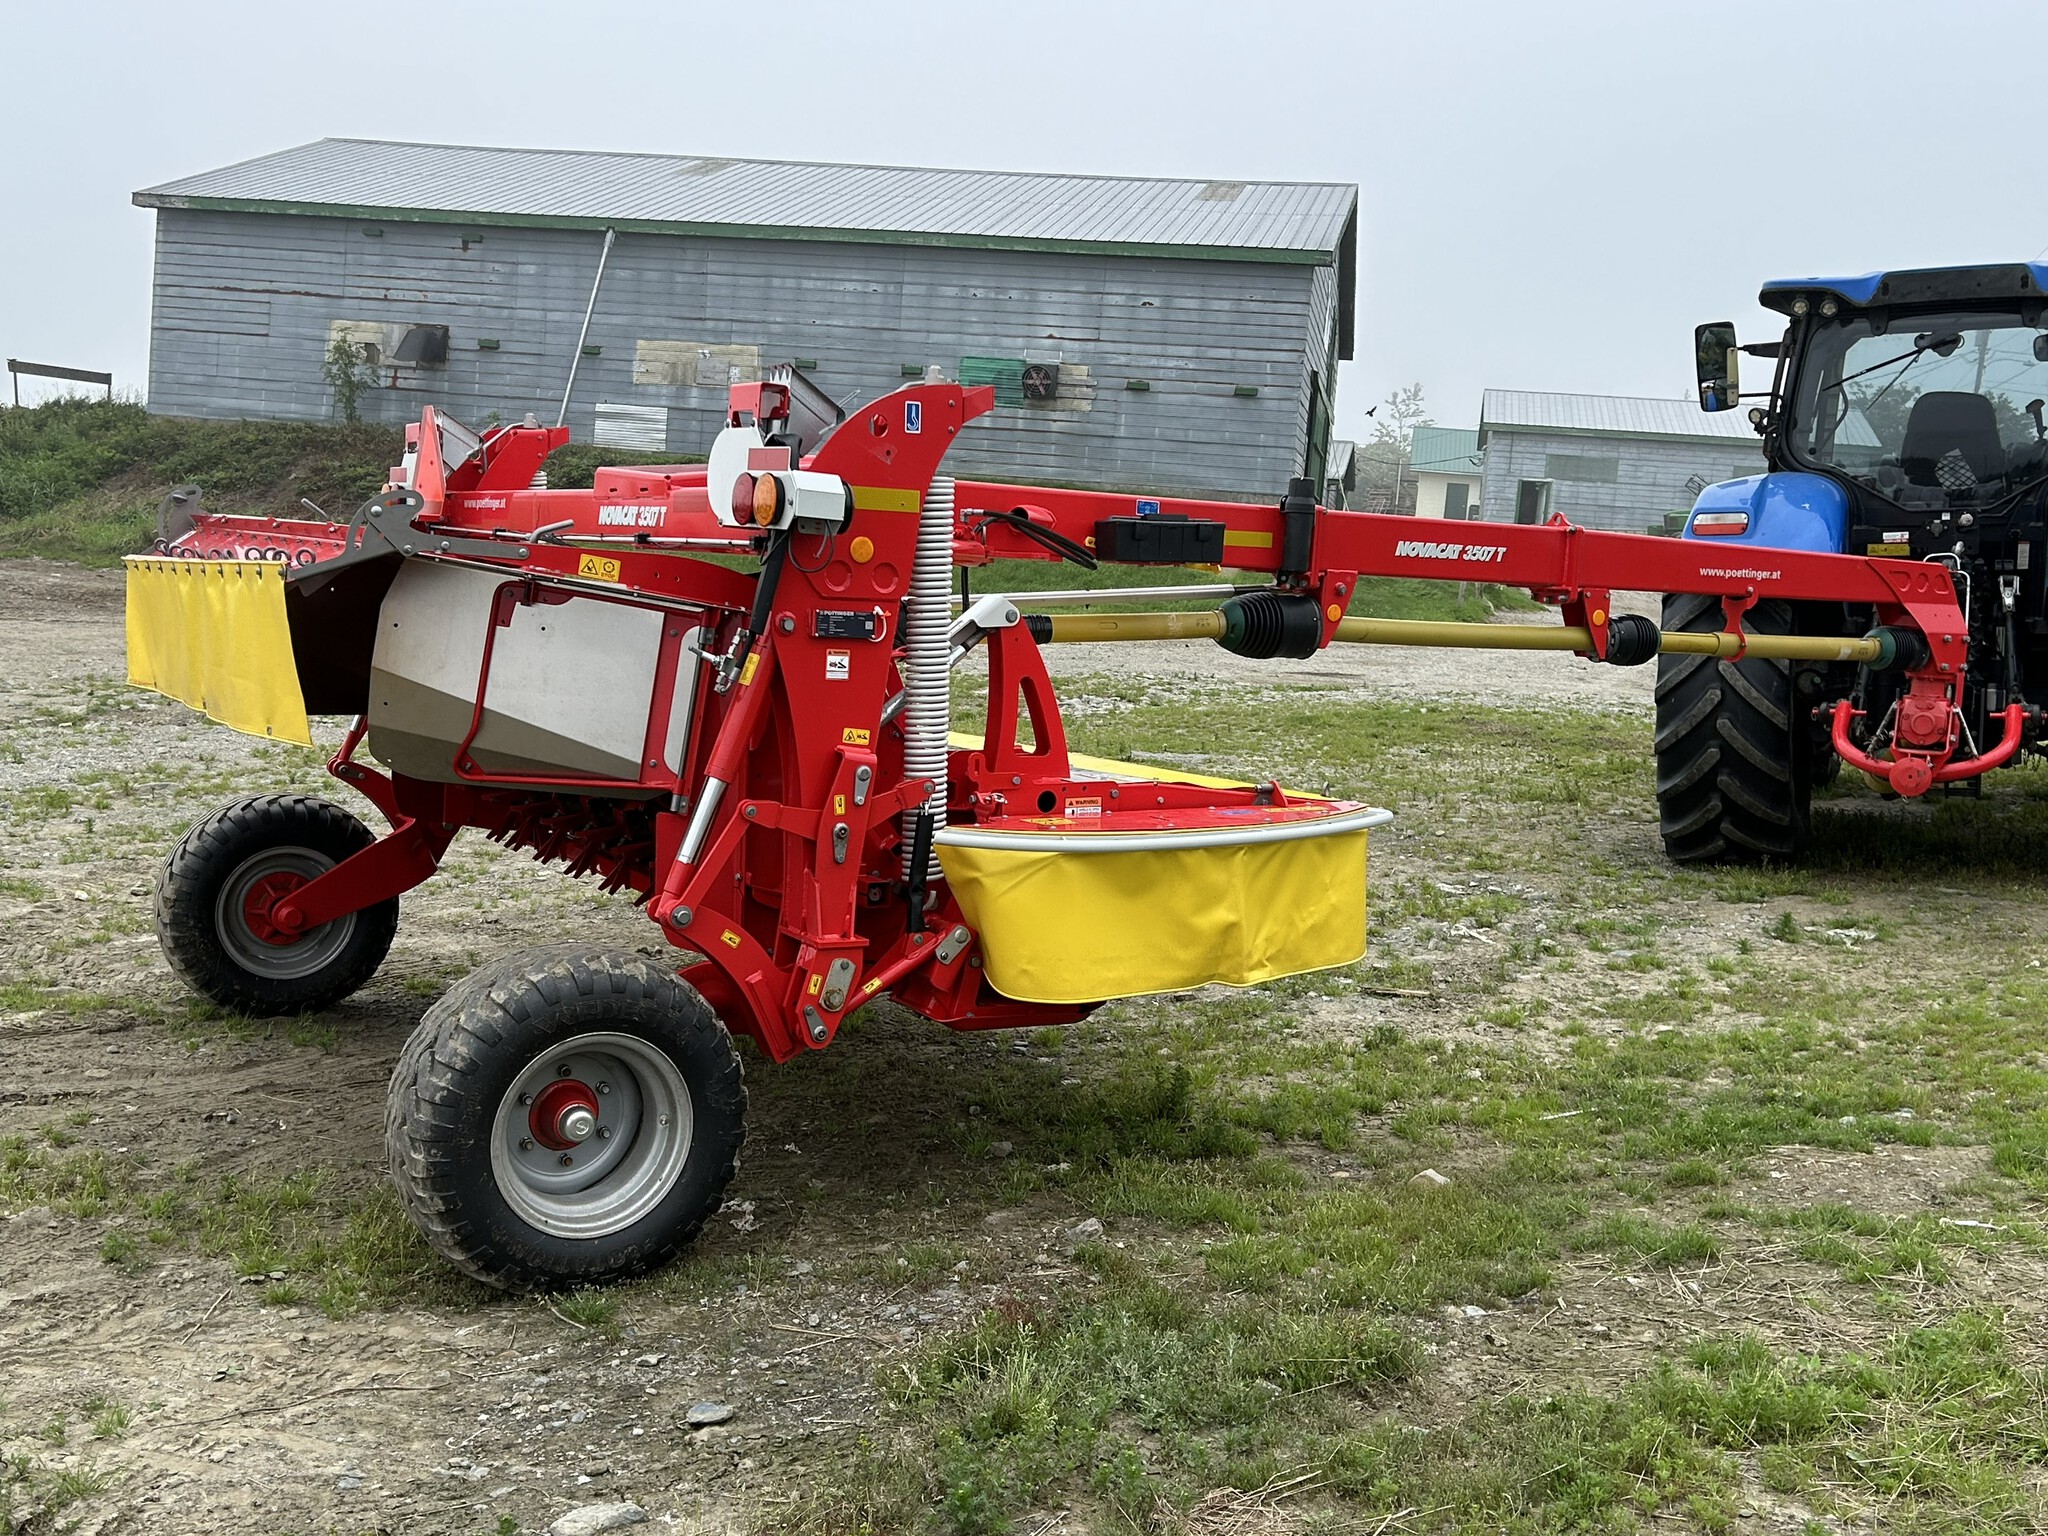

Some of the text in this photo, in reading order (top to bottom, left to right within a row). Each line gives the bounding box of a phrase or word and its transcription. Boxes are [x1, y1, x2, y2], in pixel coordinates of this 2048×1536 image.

[598, 505, 667, 527] NOVACAT 3507 T
[1395, 541, 1507, 562] NOVACAT 3507 T
[1700, 568, 1781, 581] www.poettinger.at
